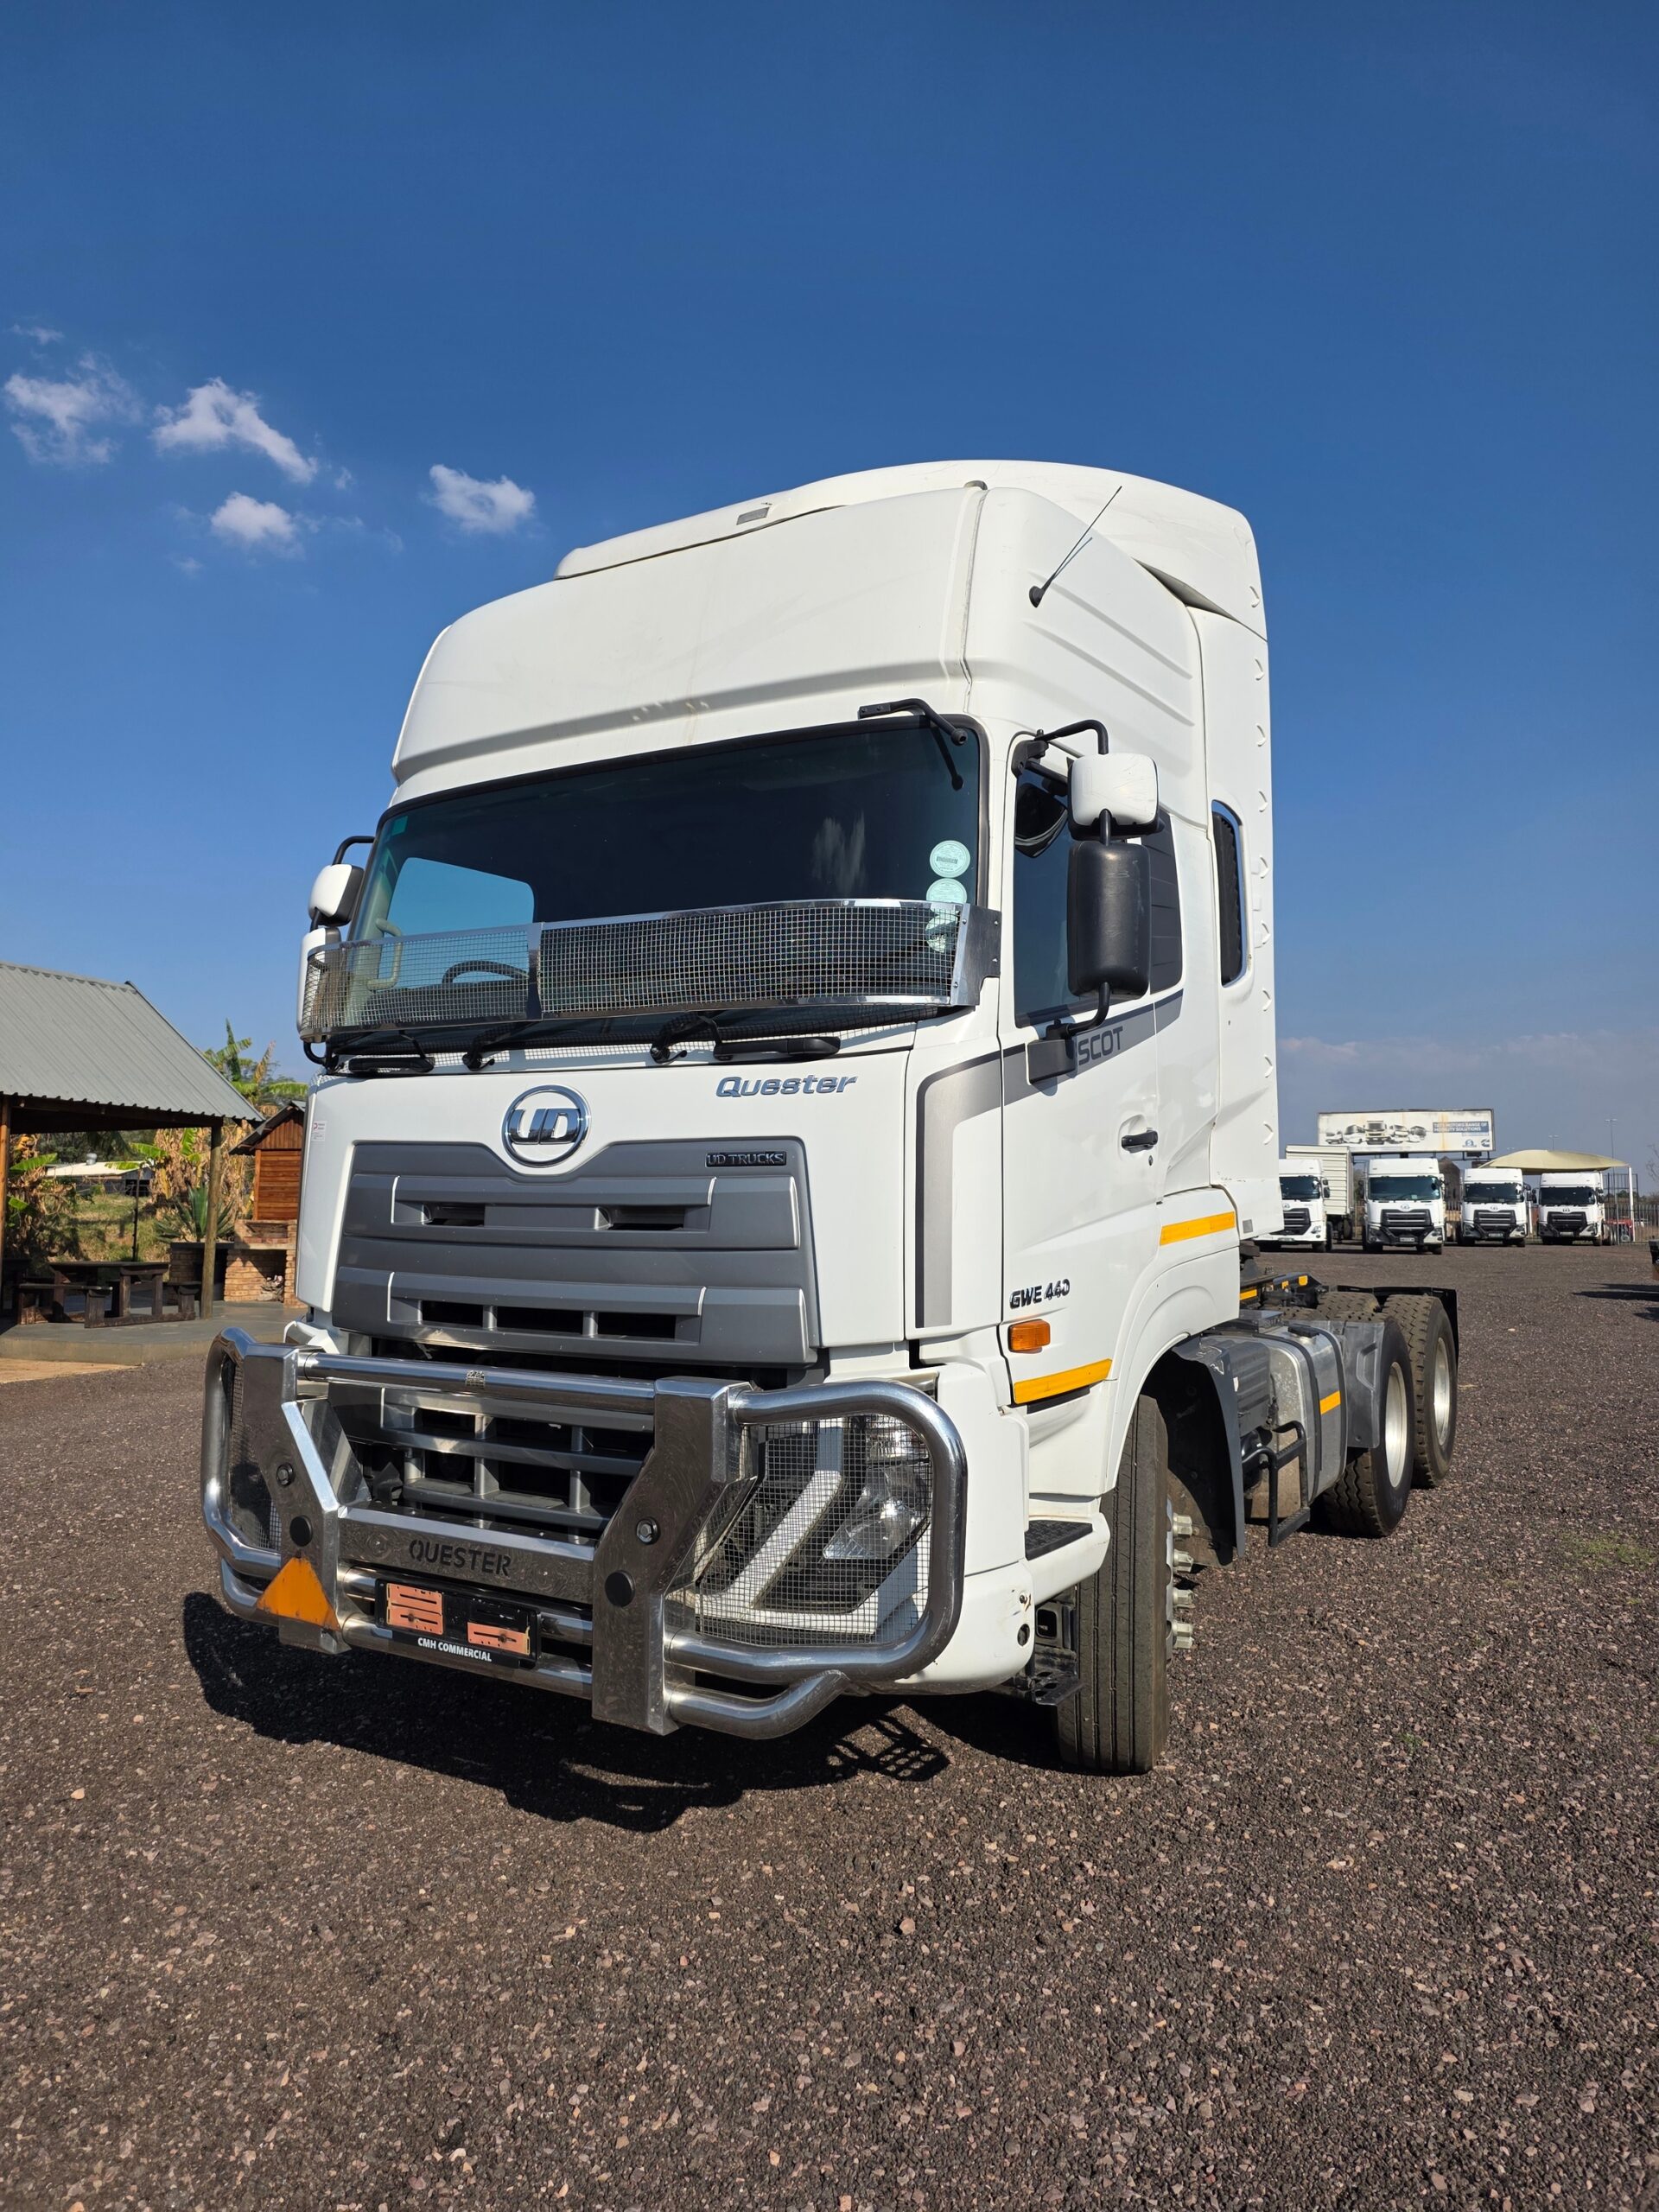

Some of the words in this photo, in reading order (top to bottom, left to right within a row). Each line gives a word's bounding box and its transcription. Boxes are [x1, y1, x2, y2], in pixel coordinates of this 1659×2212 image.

[1077, 1026, 1123, 1065] SCOT
[715, 1075, 858, 1098] Quester
[506, 1108, 582, 1145] UD
[707, 1154, 726, 1165] UD
[728, 1153, 784, 1165] TRUCKS
[1009, 1286, 1042, 1310] GWE
[1044, 1279, 1071, 1300] 440
[409, 1539, 512, 1576] QUESTER
[417, 1637, 436, 1649] CMH
[437, 1641, 493, 1662] COMMERCIAL
